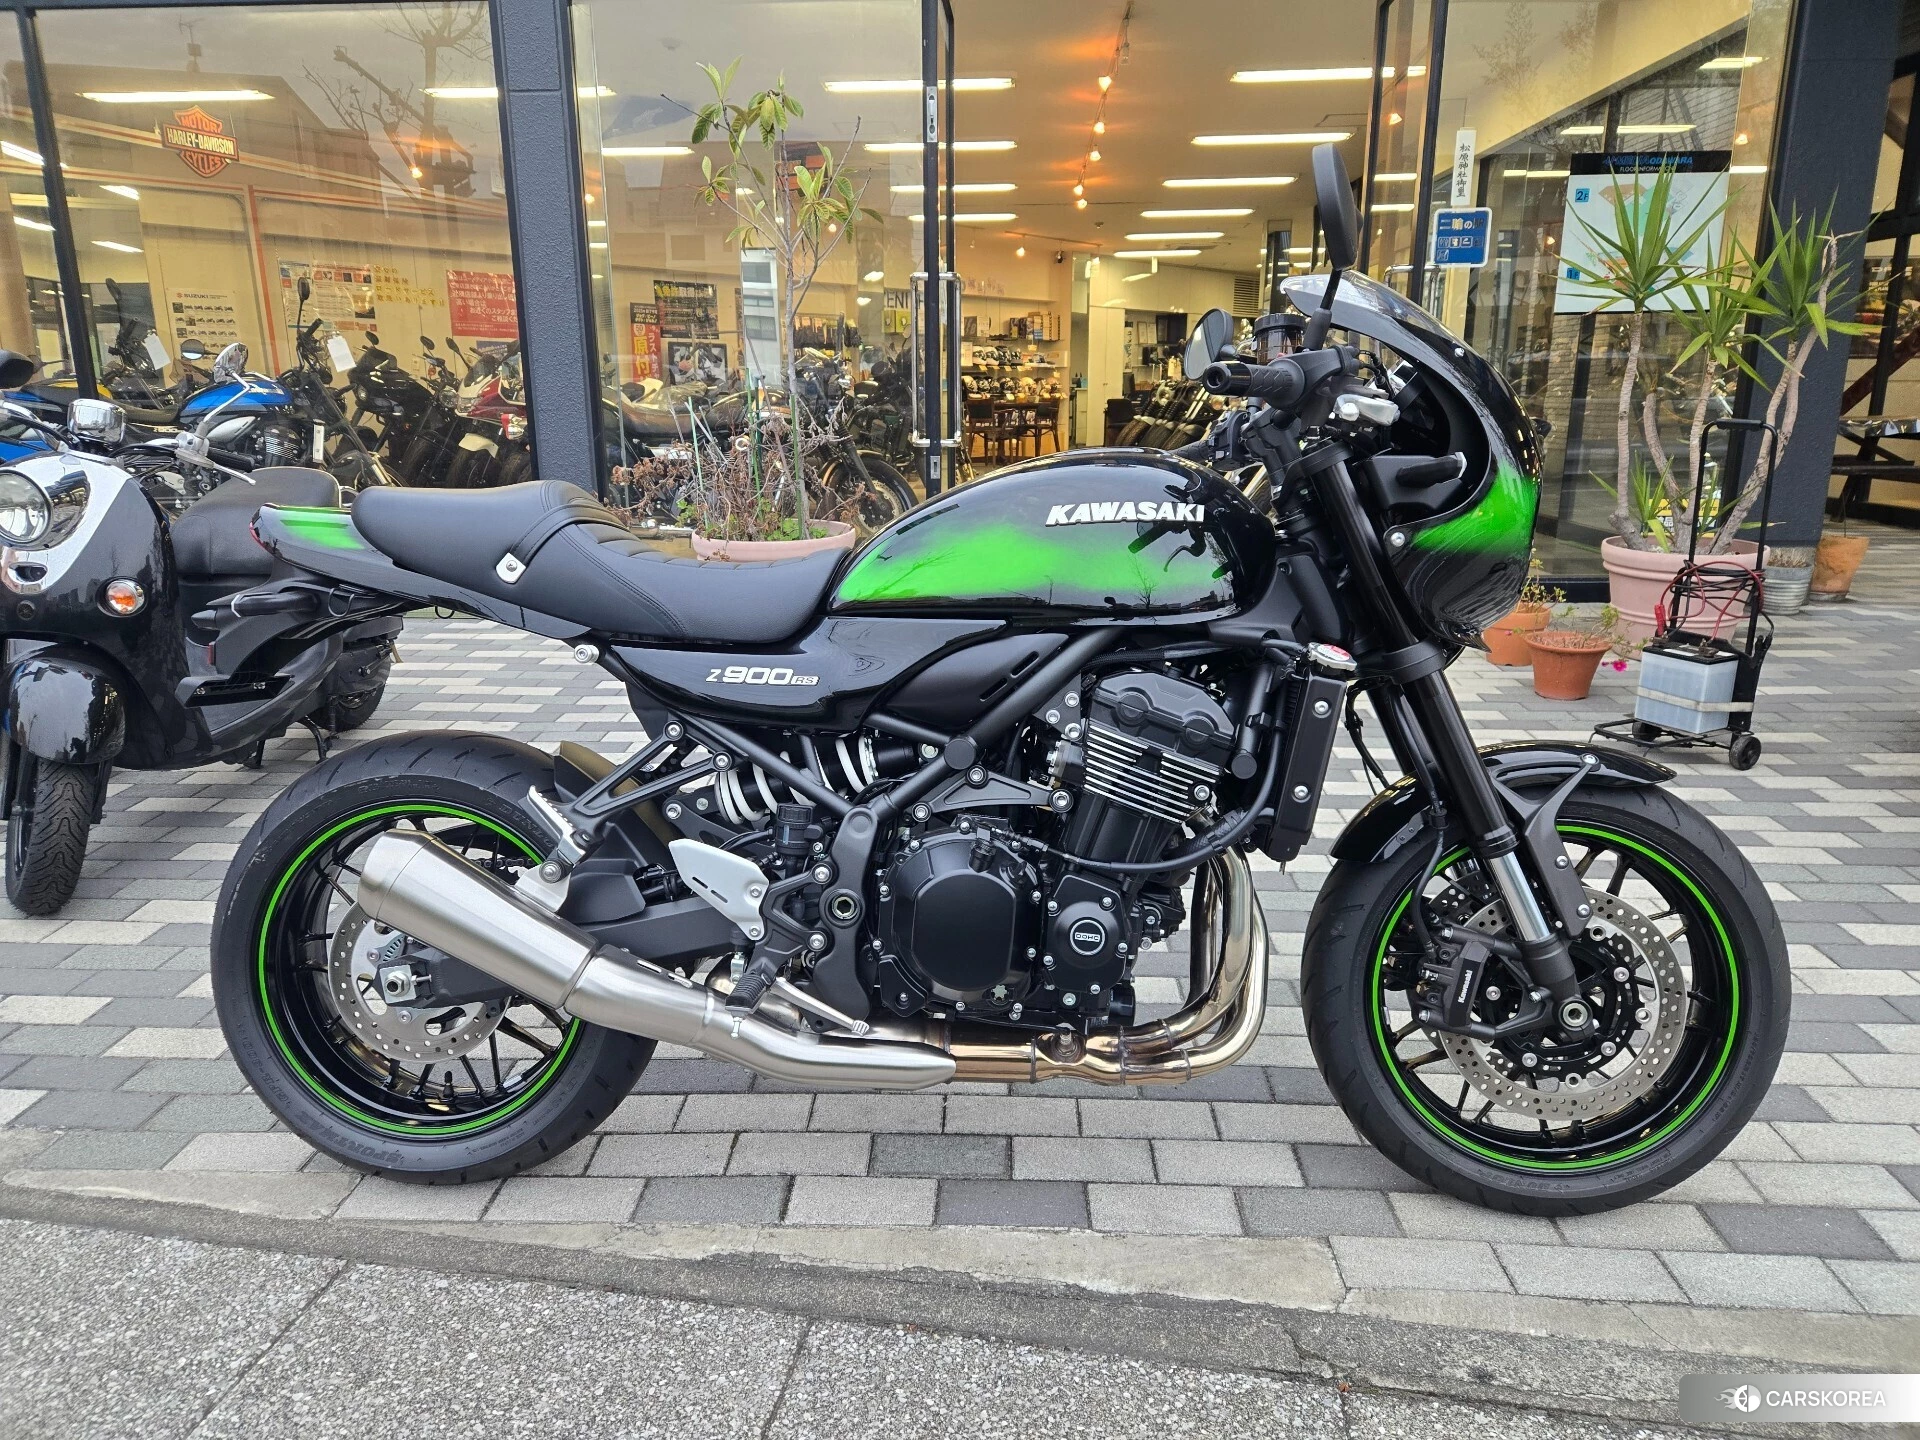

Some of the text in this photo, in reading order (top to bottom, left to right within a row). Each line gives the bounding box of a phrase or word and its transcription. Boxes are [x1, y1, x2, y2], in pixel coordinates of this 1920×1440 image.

[181, 111, 218, 133] MOTOR
[167, 127, 235, 155] HARLEY-DAVIDSON
[185, 151, 221, 173] CYCLES
[1649, 156, 1693, 165] ODWARA
[1576, 190, 1588, 200] 2F
[1046, 501, 1205, 527] KAWASAKI
[498, 803, 556, 849] DUNLO
[1075, 933, 1100, 942] DOHC
[297, 1110, 404, 1164] SPORTMAX
